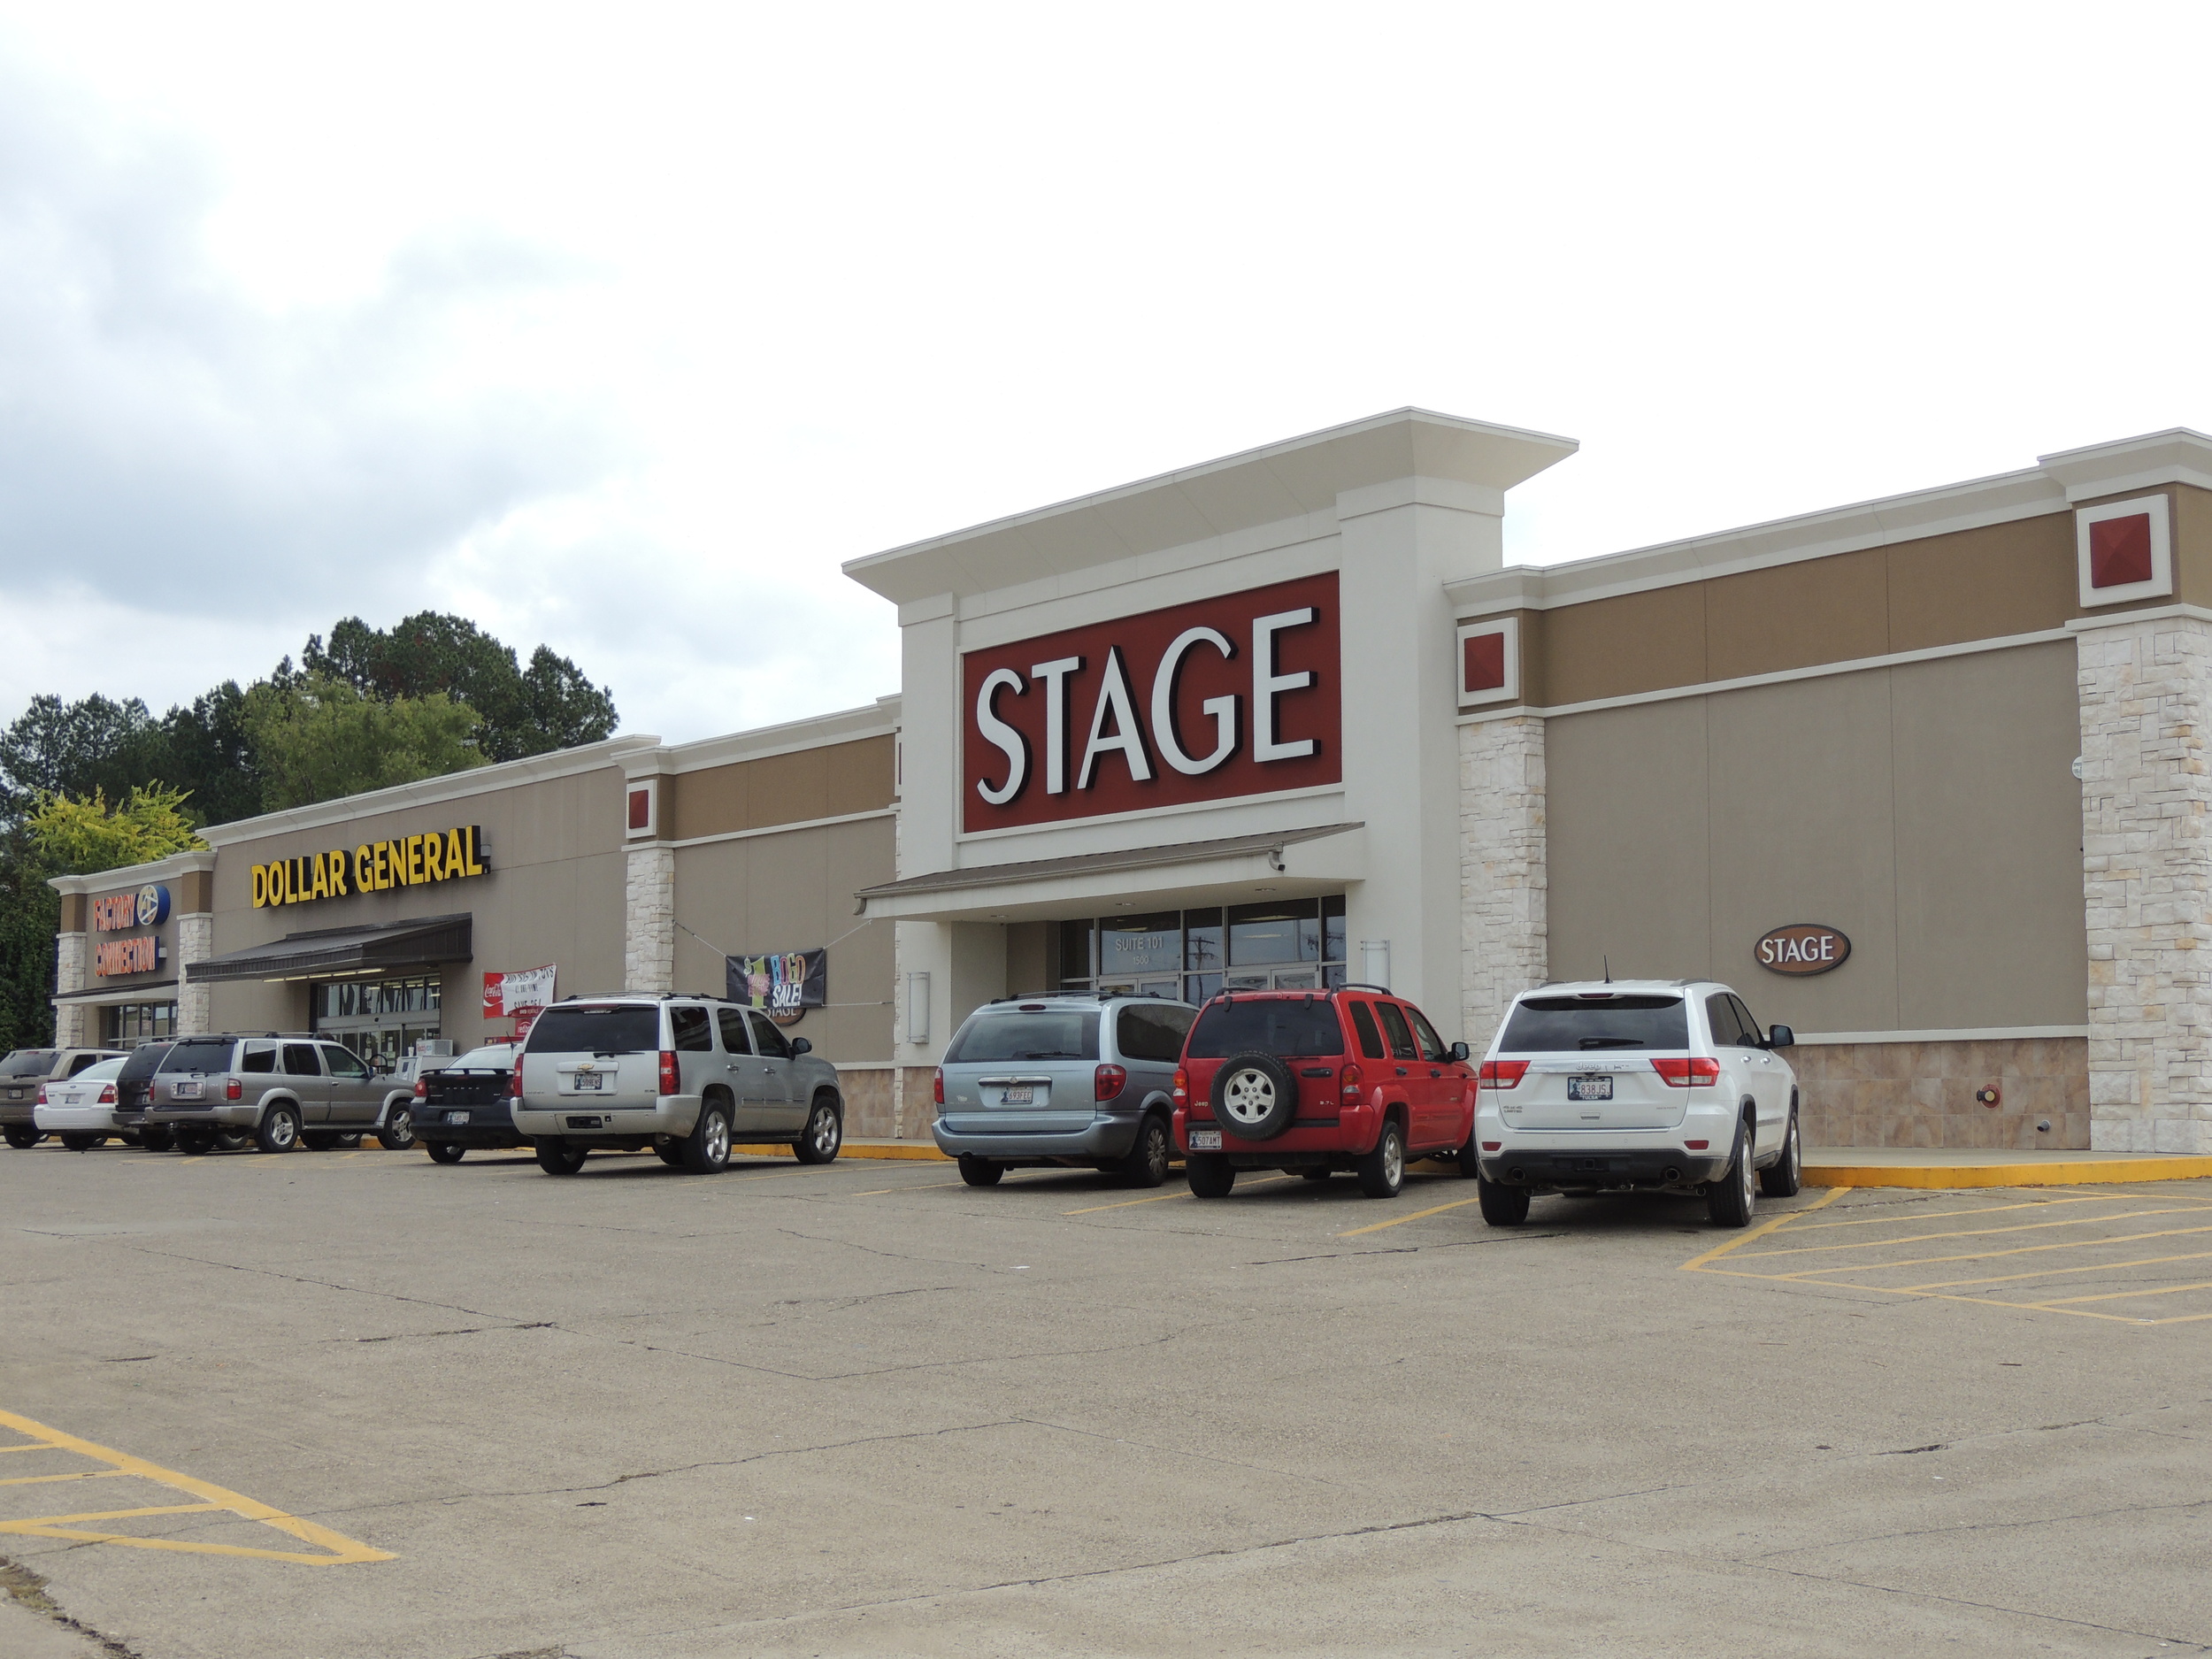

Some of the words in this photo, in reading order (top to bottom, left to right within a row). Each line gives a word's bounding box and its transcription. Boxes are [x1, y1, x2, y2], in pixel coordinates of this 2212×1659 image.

[976, 607, 1320, 805] STAGE
[251, 849, 350, 909] DOLLAR
[355, 825, 482, 894] GENERAL
[94, 894, 137, 932] FACTORY
[95, 935, 157, 977] CONNECTION
[1116, 938, 1144, 951] SUITE
[1148, 936, 1164, 949] 101
[1762, 935, 1834, 964] STAGE
[771, 953, 806, 987] BOGO
[1133, 956, 1149, 965] 1500
[772, 984, 803, 1008] SALE!
[1576, 1062, 1601, 1071] Jeep
[1009, 1091, 1032, 1100] 693FEC
[1198, 1136, 1220, 1145] 507AMT
